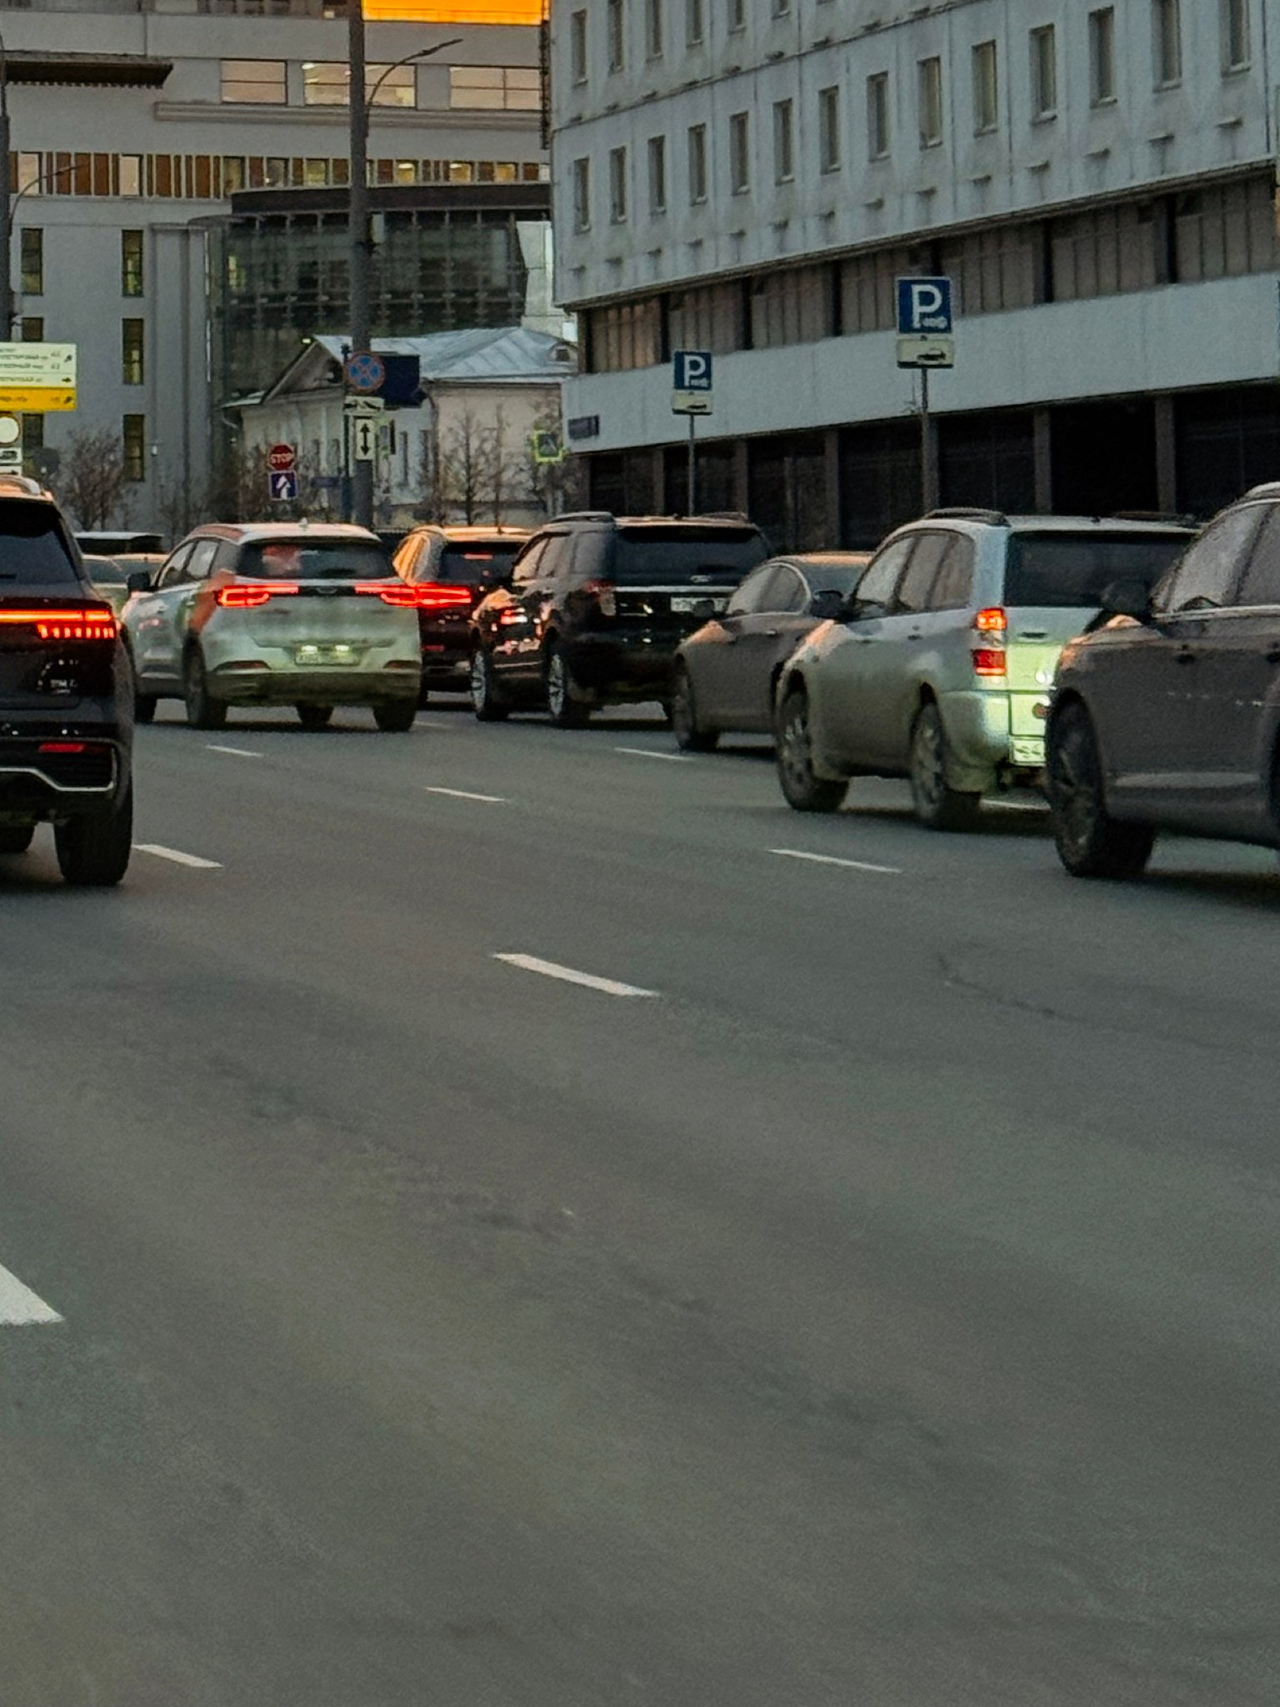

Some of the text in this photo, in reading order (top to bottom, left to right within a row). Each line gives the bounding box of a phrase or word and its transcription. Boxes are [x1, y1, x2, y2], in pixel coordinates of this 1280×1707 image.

[911, 284, 942, 329] P
[684, 355, 706, 386] P
[270, 453, 295, 464] STOP
